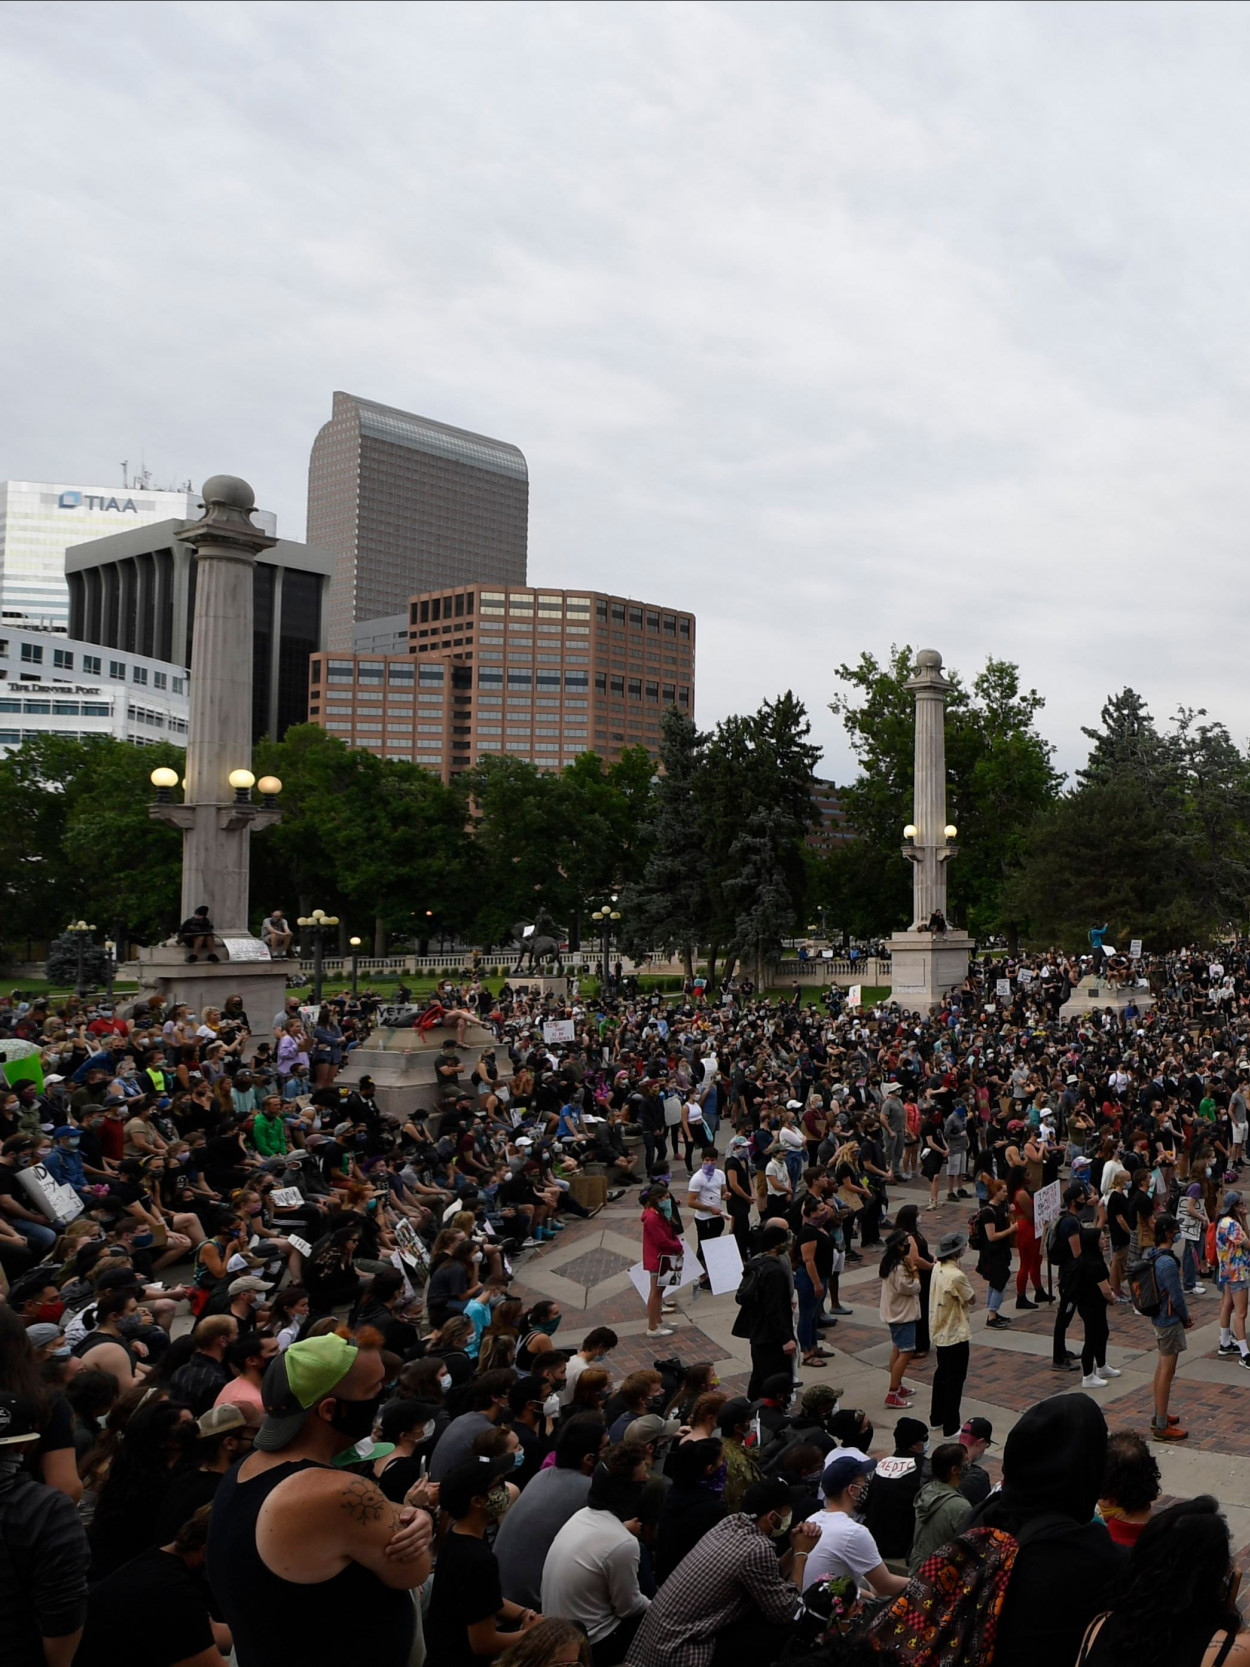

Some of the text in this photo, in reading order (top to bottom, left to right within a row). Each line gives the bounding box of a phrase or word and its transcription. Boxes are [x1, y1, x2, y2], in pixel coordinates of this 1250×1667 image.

[84, 495, 138, 513] TIAA
[7, 682, 101, 694] THE DENVER POST
